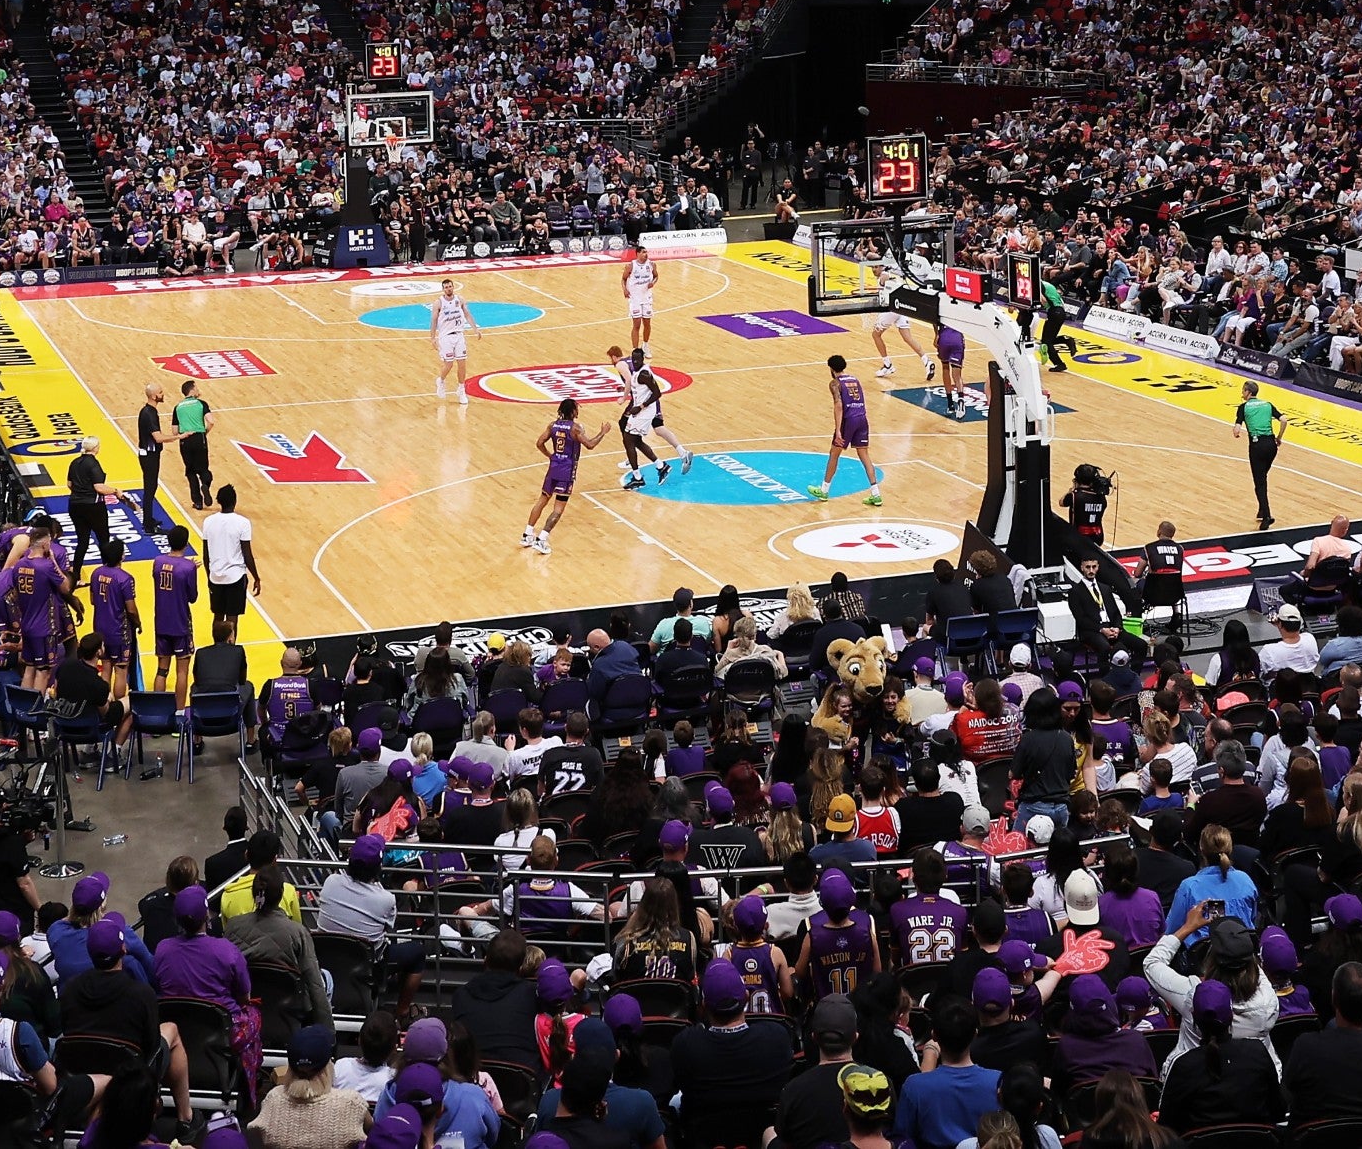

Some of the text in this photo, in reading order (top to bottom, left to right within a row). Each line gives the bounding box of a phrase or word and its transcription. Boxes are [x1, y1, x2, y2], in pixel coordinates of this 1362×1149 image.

[375, 46, 397, 57] 4:01
[372, 57, 395, 76] 23
[883, 142, 919, 160] 4:01
[878, 161, 915, 193] 23
[112, 253, 622, 293] Harvey Norman
[115, 266, 159, 278] HOOPS CAPITAL
[1089, 309, 1147, 328] ACORN ACORN ACORN
[1148, 329, 1210, 350] ACORN ACORN ACORN
[520, 372, 582, 401] HUNGRY
[47, 412, 84, 436] Arena
[556, 437, 566, 453] 2
[704, 454, 808, 501] BLACKMORES
[1084, 503, 1103, 512] WATCH
[1157, 545, 1179, 554] WATCH
[18, 576, 34, 595] 25
[159, 571, 173, 591] 11
[99, 583, 108, 603] 4
[274, 682, 306, 690] Beyond Bank
[284, 701, 297, 720] 3
[968, 718, 999, 729] NAIDOC
[551, 771, 586, 795] 22
[908, 915, 955, 928] WARE JR.
[908, 929, 956, 962] 22
[820, 952, 850, 965] WALTON
[828, 967, 857, 996] 11
